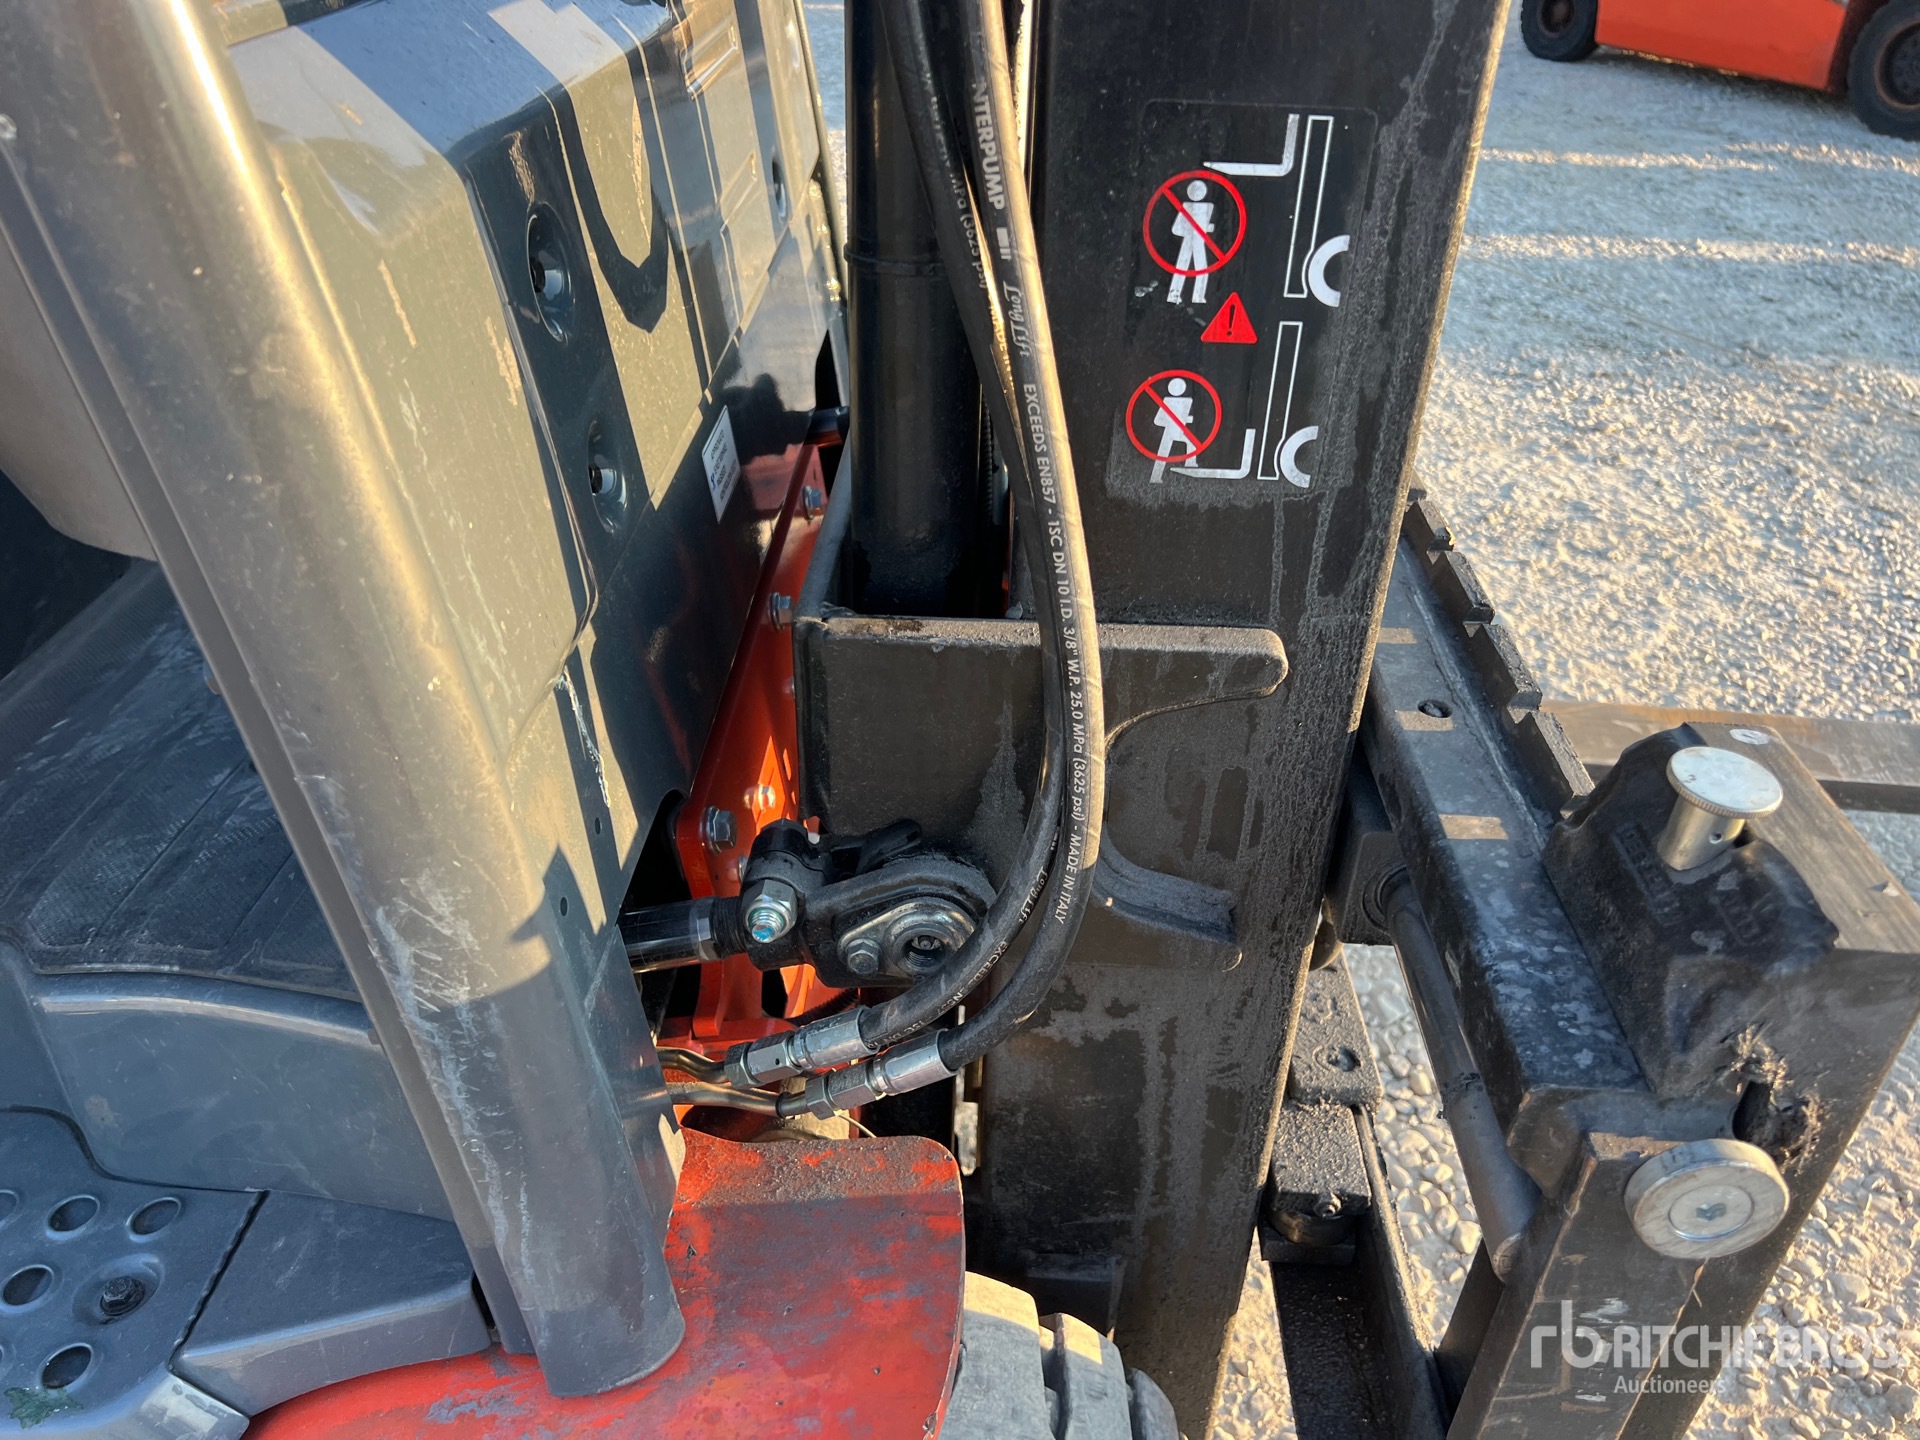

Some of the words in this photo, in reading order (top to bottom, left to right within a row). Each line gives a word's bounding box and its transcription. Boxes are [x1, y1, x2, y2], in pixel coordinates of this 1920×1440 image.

[1023, 384, 1047, 453] EXCEEDS
[1036, 457, 1057, 504] EN857
[1048, 521, 1063, 547] 1SC
[1053, 552, 1067, 574] DN
[1057, 580, 1070, 595] 10
[1060, 600, 1072, 622] I.D.
[1067, 659, 1081, 687] W.P.
[1072, 722, 1085, 753] MPa
[1072, 757, 1087, 795] (3625
[1071, 796, 1086, 821] psi)
[1065, 833, 1082, 874] MADE
[1061, 874, 1077, 892] IN
[1054, 891, 1072, 925] ITALY
